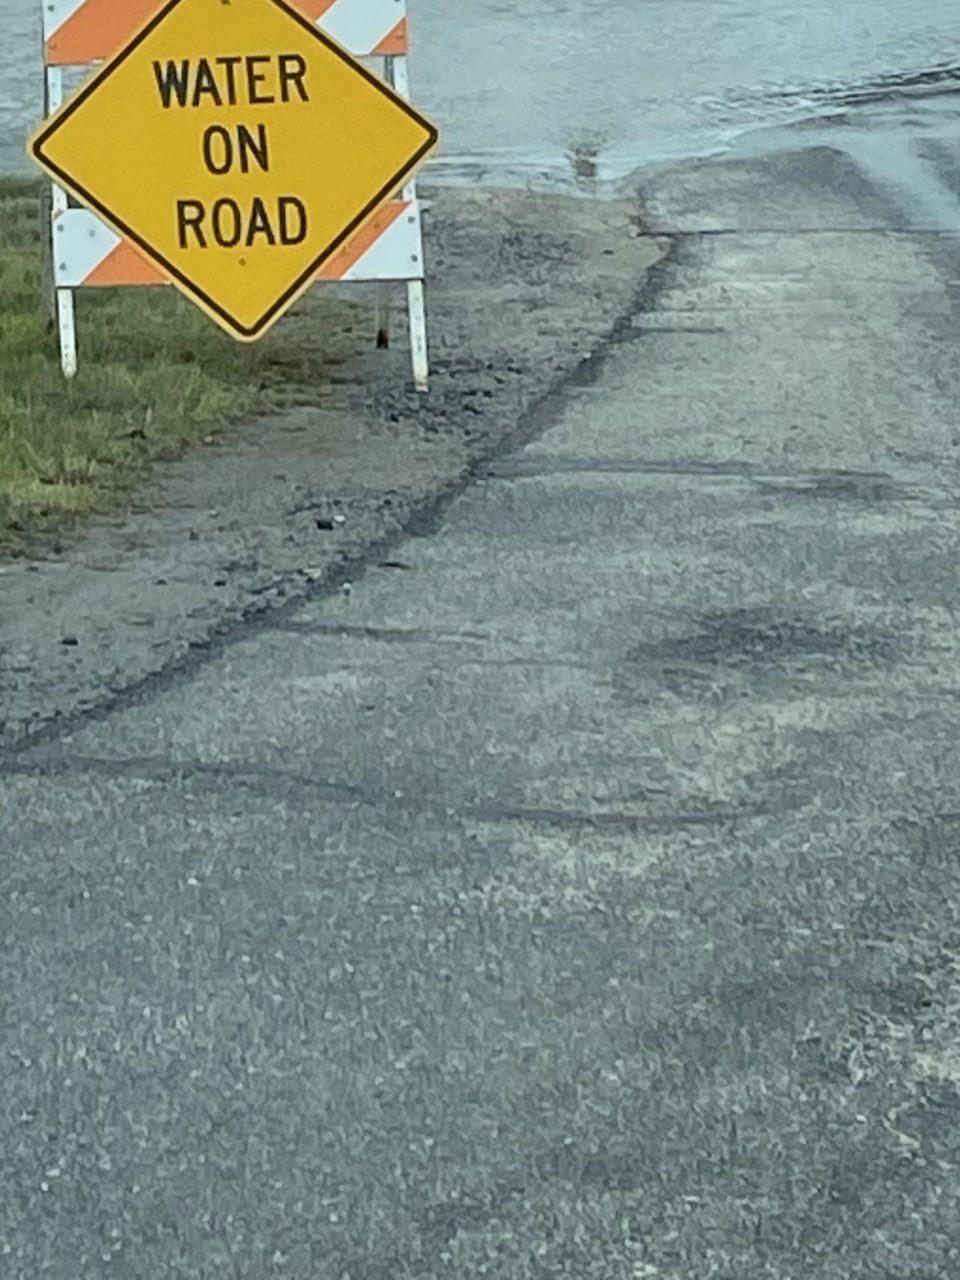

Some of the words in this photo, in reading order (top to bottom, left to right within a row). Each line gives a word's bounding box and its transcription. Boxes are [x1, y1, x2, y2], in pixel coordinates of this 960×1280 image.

[152, 53, 310, 109] WATER
[202, 123, 270, 175] ON
[176, 196, 308, 249] ROAD
